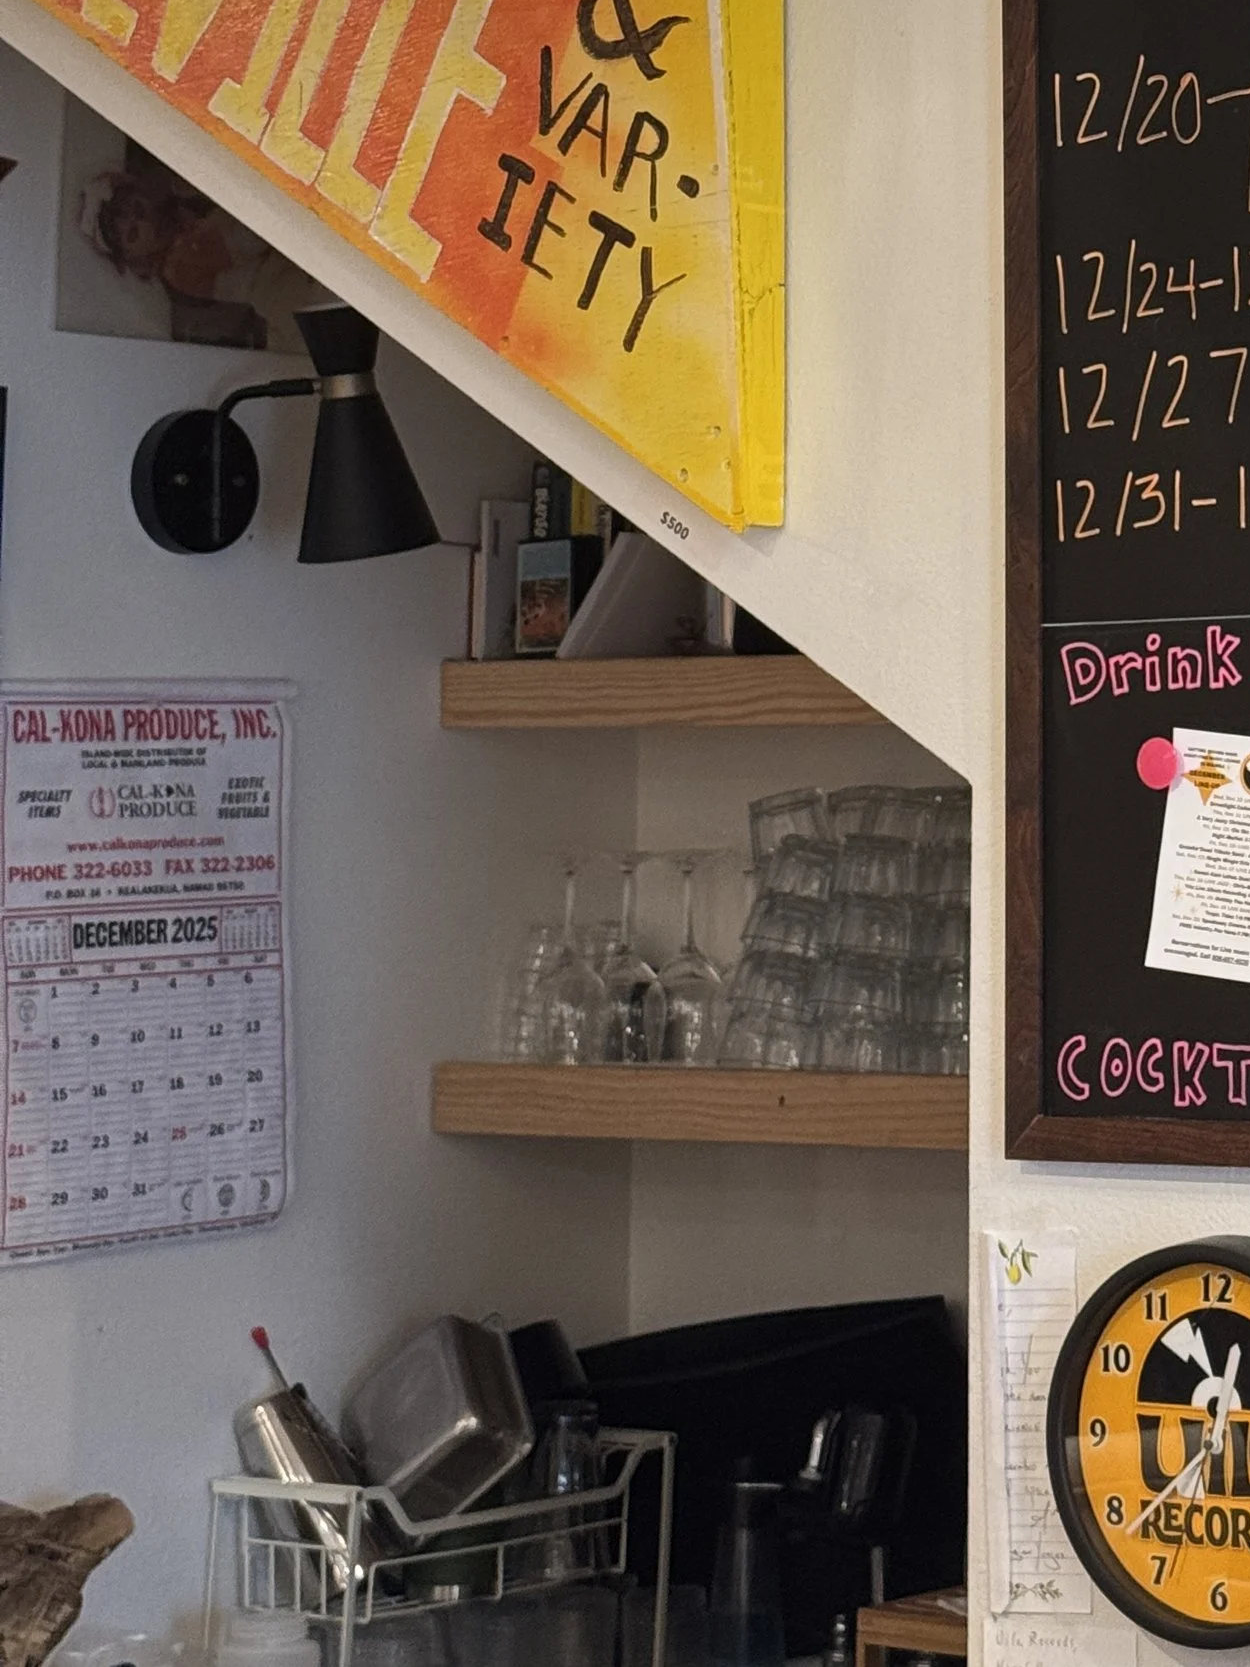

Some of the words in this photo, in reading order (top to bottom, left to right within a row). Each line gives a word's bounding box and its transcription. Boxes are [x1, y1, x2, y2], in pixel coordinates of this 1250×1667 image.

[477, 153, 688, 353] IETY
[1058, 347, 1248, 440] 12/27
[658, 509, 689, 541] $500
[1060, 625, 1241, 706] Drink
[12, 708, 116, 744] CAL-KONA
[122, 707, 226, 746] PRODUCE,
[232, 708, 278, 740] INC.
[118, 800, 197, 819] PRODUCE
[8, 864, 67, 882] PHONE
[74, 860, 152, 879] 322-6033
[164, 858, 195, 875] FAX
[72, 920, 168, 950] DECEMBER
[172, 916, 218, 944] 2025
[51, 986, 58, 998] 1
[92, 983, 100, 995] 2
[131, 980, 139, 992] 3
[170, 978, 177, 990] 4
[207, 975, 214, 987] 5
[244, 972, 252, 984] 6
[12, 1040, 19, 1052] 7
[52, 1036, 60, 1050] 8
[90, 1034, 99, 1046] 9
[131, 1030, 145, 1043] 10
[170, 1027, 182, 1040] 11
[209, 1024, 223, 1036] 12
[246, 1020, 260, 1033] 13
[10, 1092, 26, 1105] 14
[52, 1088, 68, 1102] 15
[92, 1084, 106, 1097] 16
[132, 1080, 144, 1093] 17
[170, 1077, 184, 1090] 18
[209, 1074, 222, 1086] 19
[248, 1070, 262, 1082] 20
[8, 1144, 24, 1157] 21
[51, 1140, 68, 1154] 22
[92, 1135, 109, 1148] 23
[133, 1132, 148, 1145] 24
[172, 1127, 187, 1141] 25
[210, 1124, 225, 1136] 26
[250, 1120, 264, 1133] 27
[8, 1197, 27, 1210] 28
[51, 1192, 68, 1206] 29
[92, 1187, 108, 1201] 30
[132, 1184, 147, 1196] 31
[1200, 1272, 1233, 1304] 12
[1144, 1291, 1169, 1322] 11
[1101, 1343, 1131, 1373] 10
[1090, 1418, 1107, 1447] 9
[1106, 1495, 1124, 1525] 8
[1150, 1555, 1167, 1586] 7
[1210, 1581, 1228, 1613] 6
